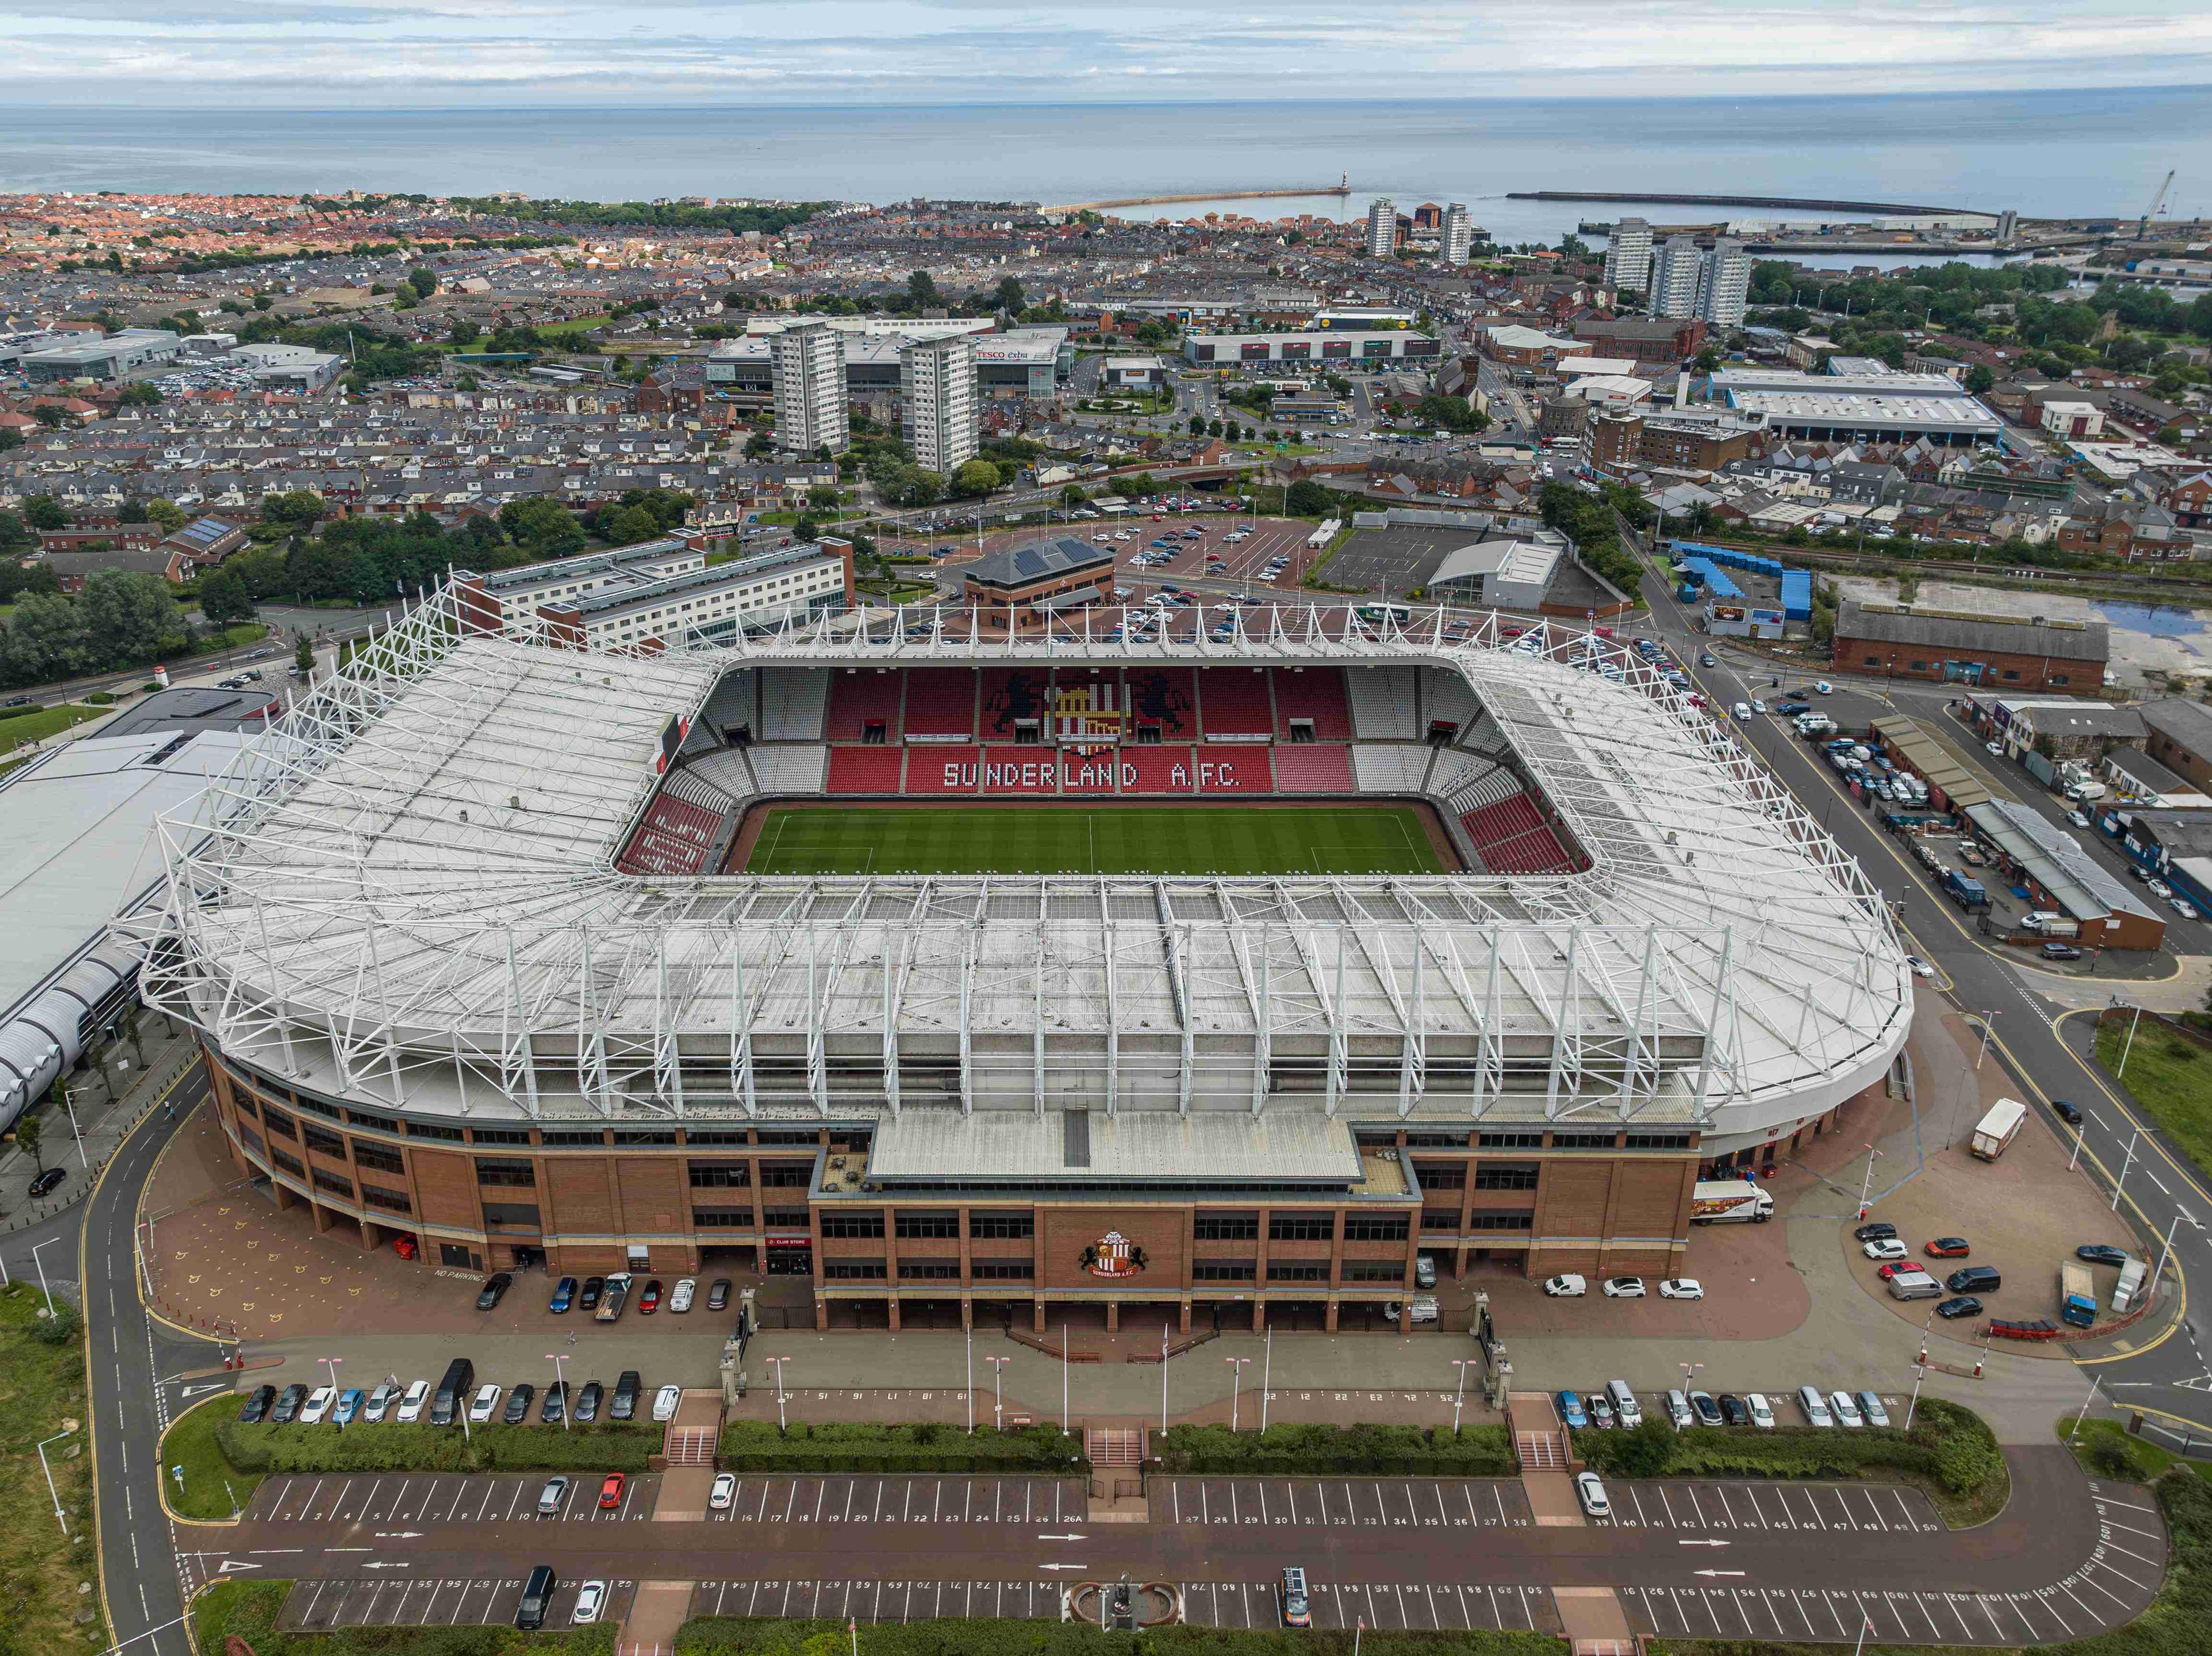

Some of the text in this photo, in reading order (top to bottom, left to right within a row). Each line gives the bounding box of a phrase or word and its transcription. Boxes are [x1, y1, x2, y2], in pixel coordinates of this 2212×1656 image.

[1008, 350, 1028, 358] extra
[944, 763, 1139, 787] SUNDERLAND
[448, 1271, 483, 1282] PARKING
[2101, 1526, 2111, 1541] 109
[2094, 1545, 2106, 1559] 108
[2062, 1575, 2077, 1588] 106
[2040, 1585, 2058, 1597] 105
